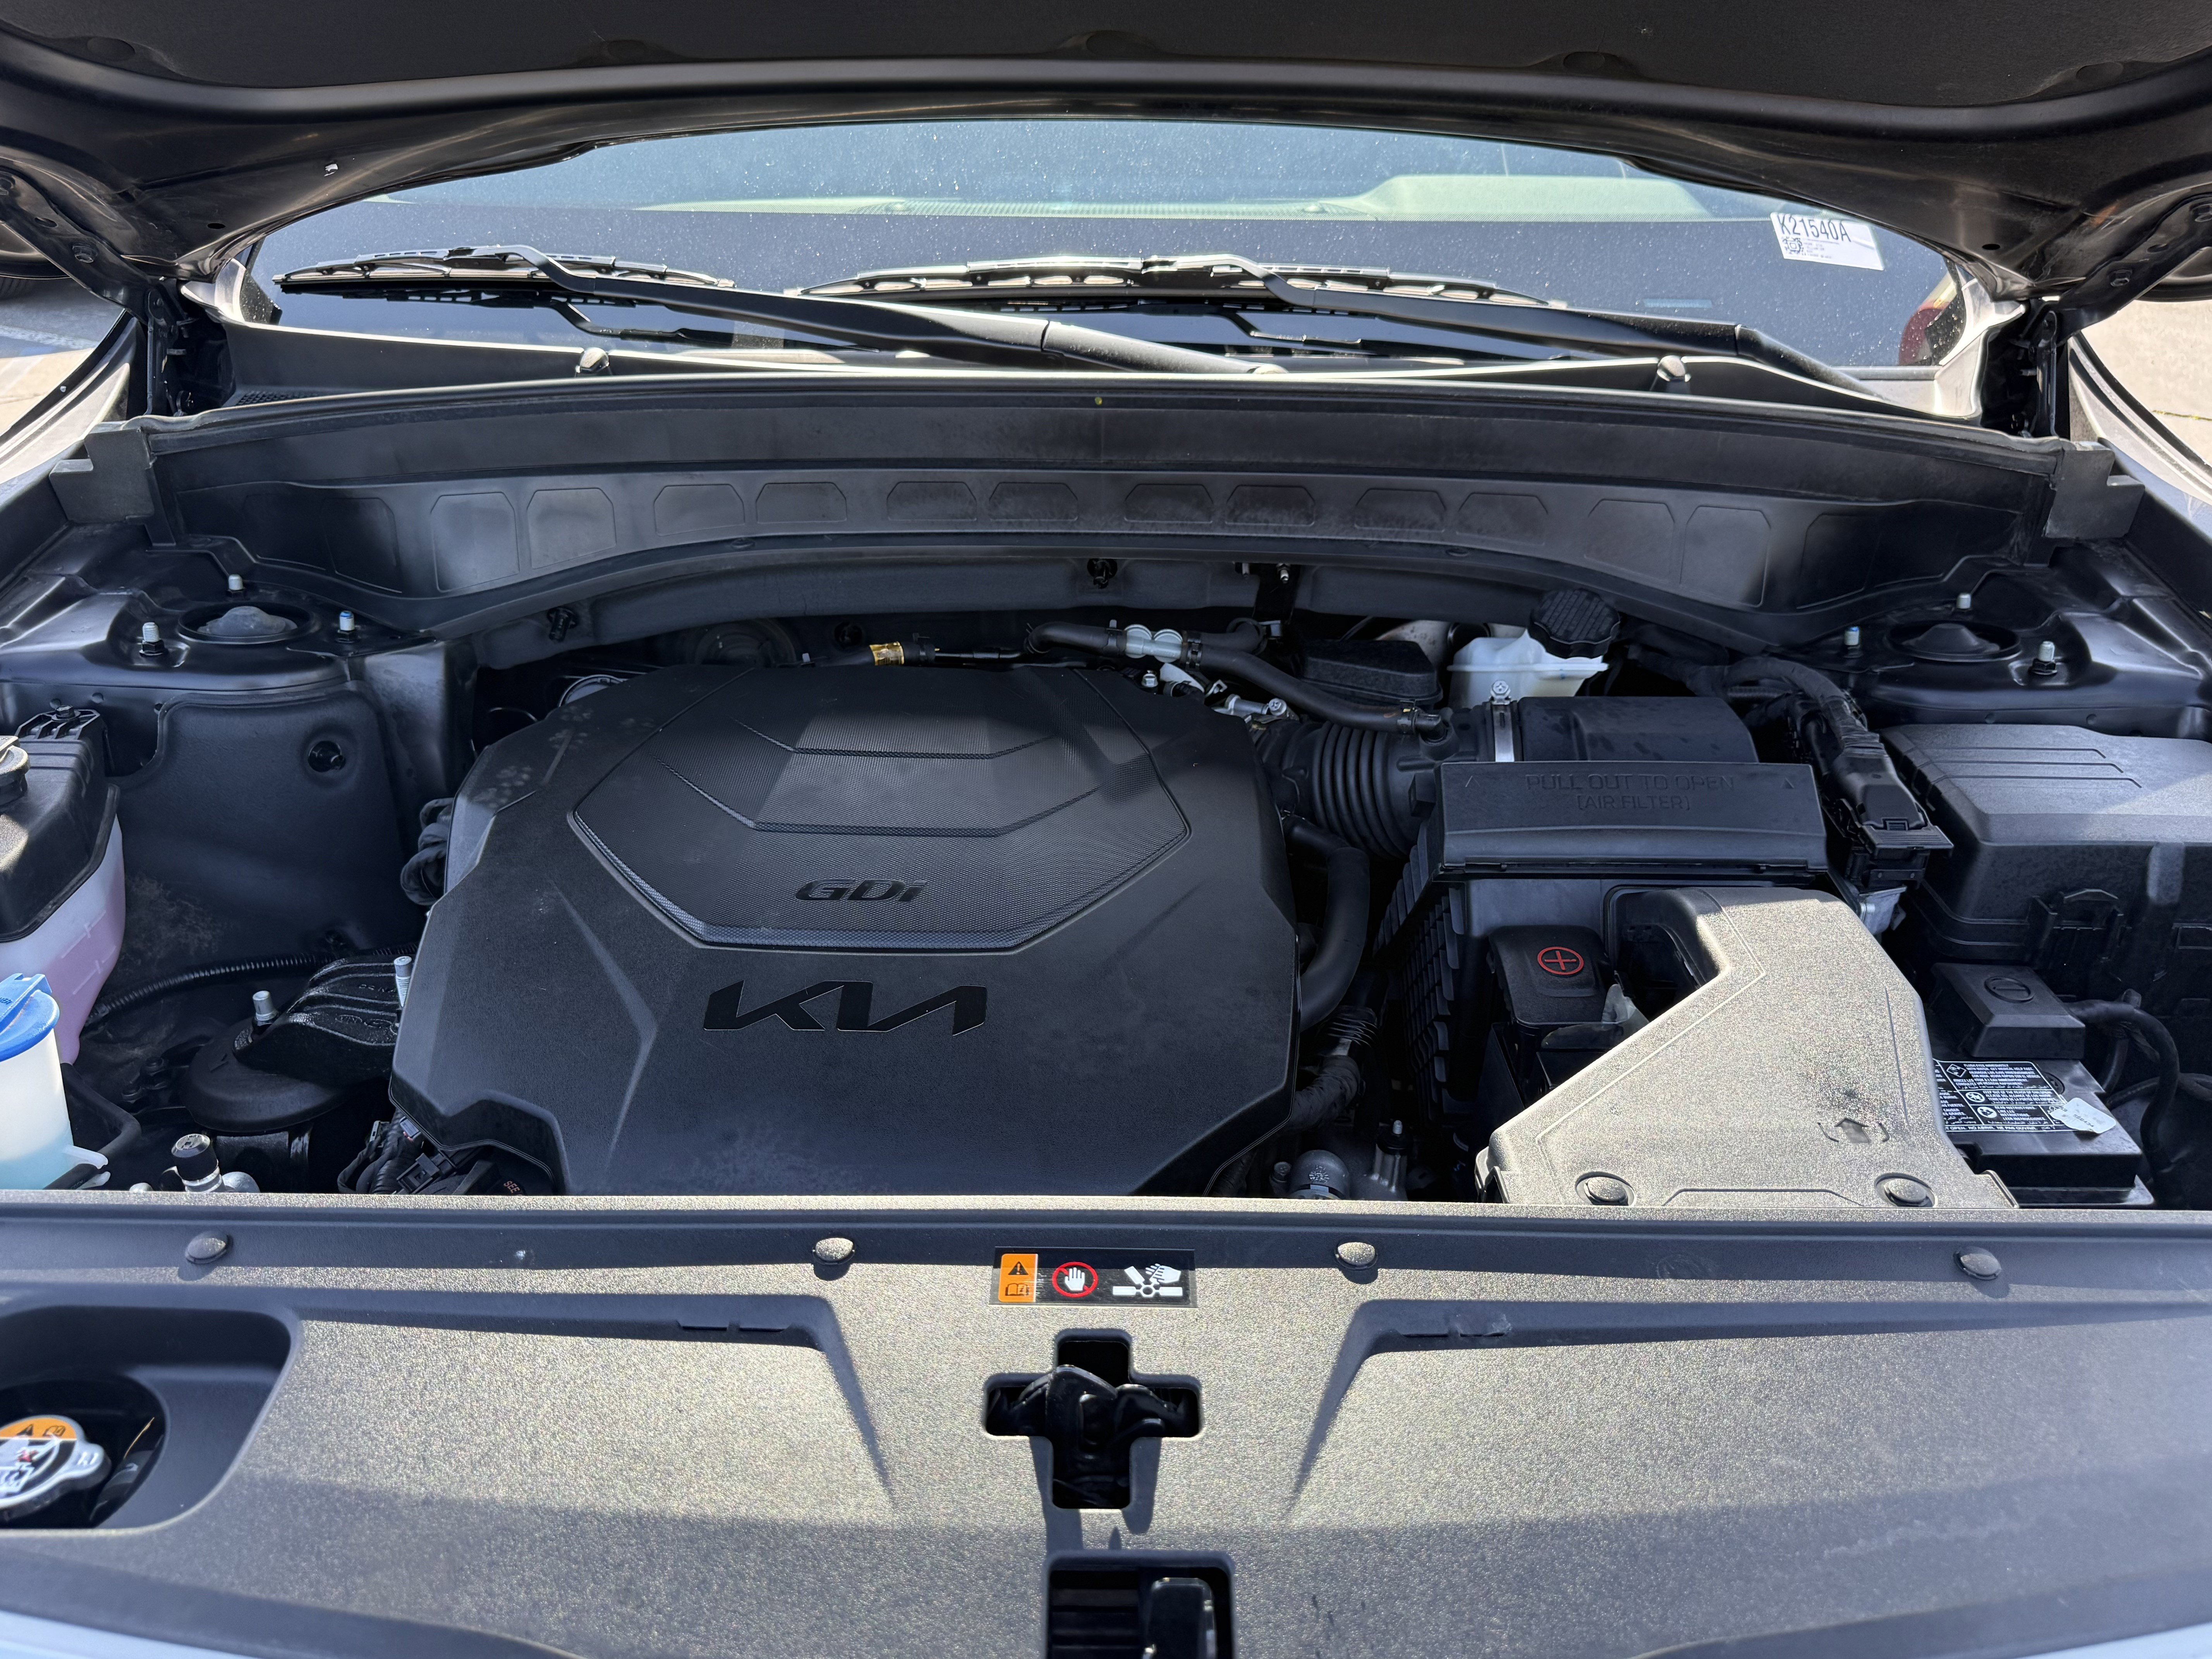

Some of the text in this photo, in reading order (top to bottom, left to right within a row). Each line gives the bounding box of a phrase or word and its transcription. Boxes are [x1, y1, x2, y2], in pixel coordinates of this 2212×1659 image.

[1777, 213, 1852, 242] K21540A
[1525, 774, 1735, 791] PULL OUT TO OPEN
[795, 878, 927, 902] GDi
[503, 1181, 520, 1193] SEE
